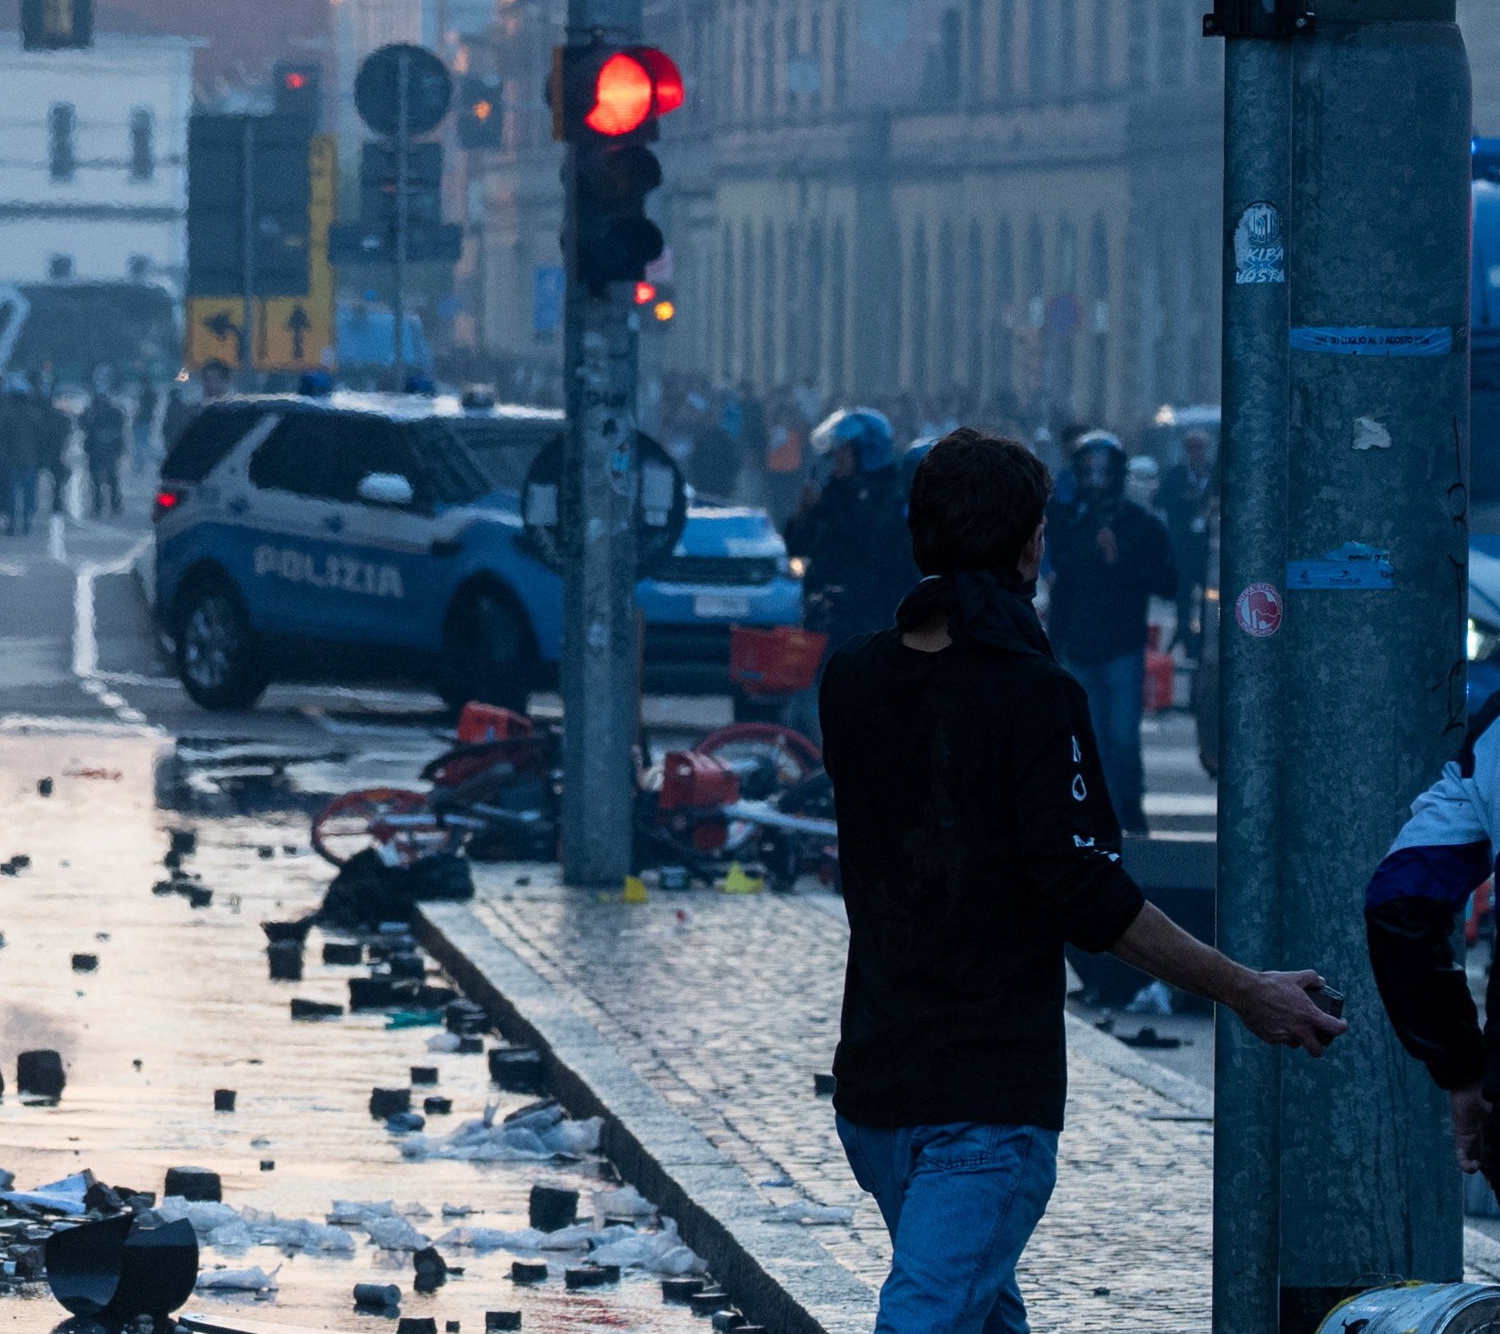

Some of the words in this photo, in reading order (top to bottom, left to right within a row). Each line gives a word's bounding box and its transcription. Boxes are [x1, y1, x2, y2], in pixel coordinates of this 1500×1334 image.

[1341, 336, 1366, 345] LUGLIO
[1368, 336, 1377, 345] AL
[1386, 336, 1413, 345] AGOSTO
[252, 543, 405, 599] POLIZIA
